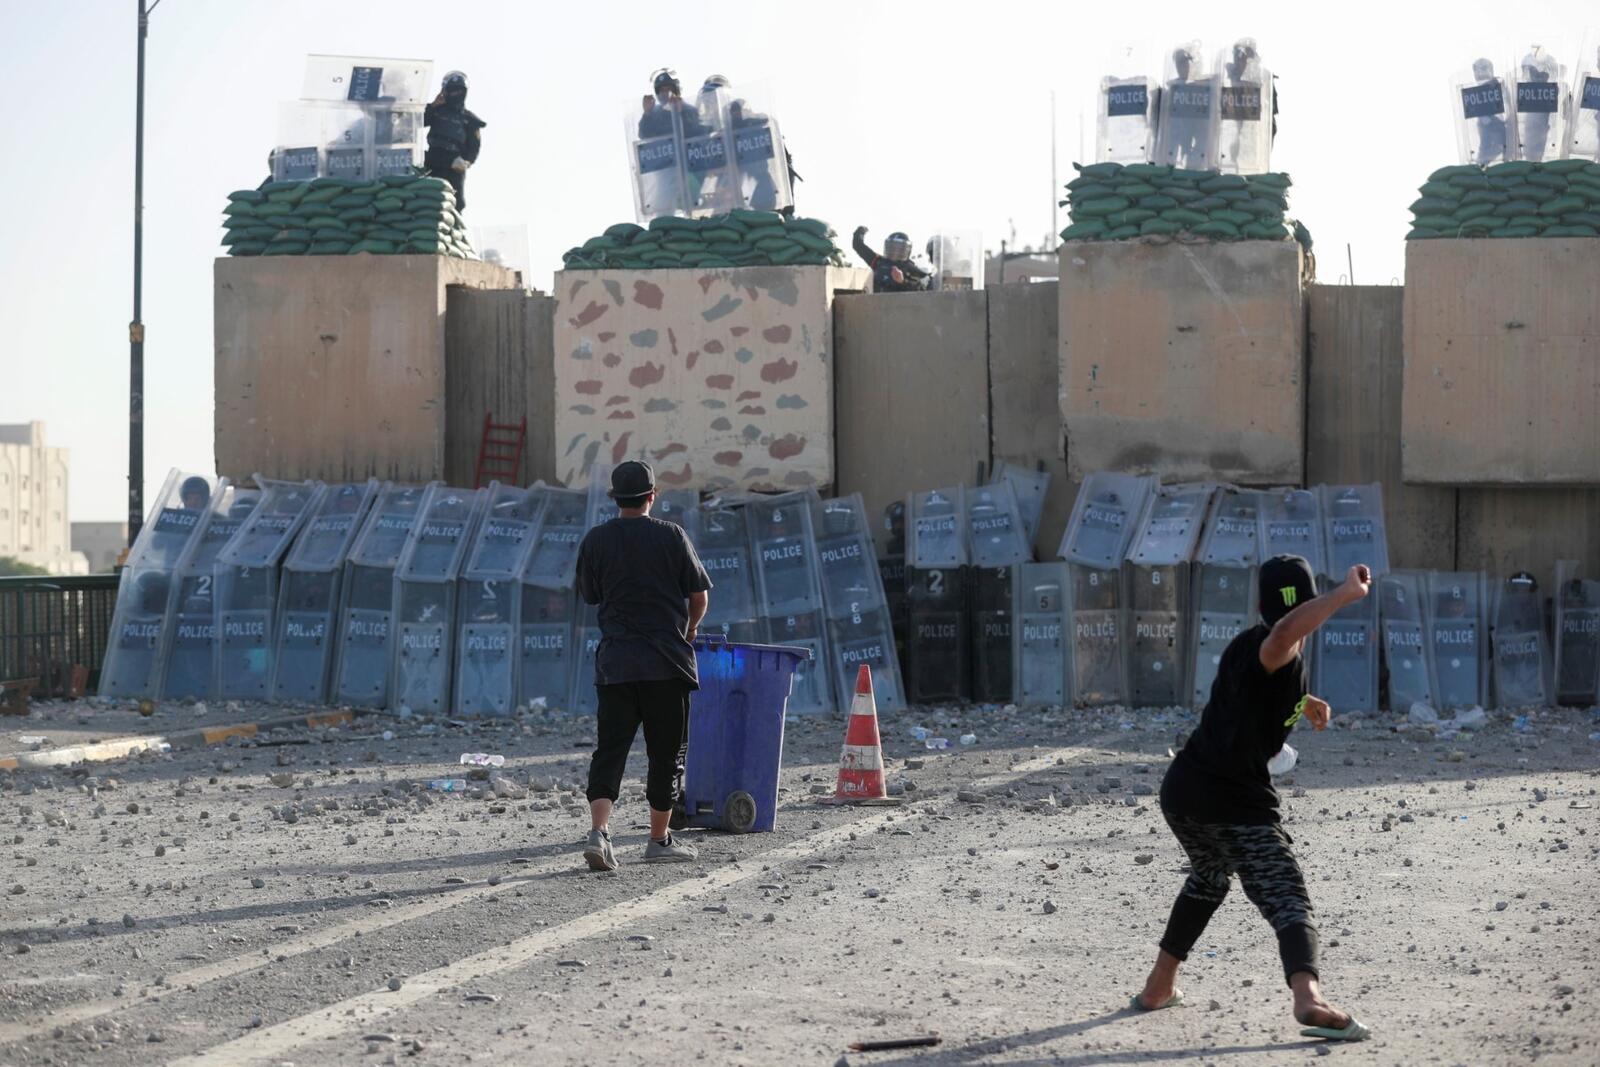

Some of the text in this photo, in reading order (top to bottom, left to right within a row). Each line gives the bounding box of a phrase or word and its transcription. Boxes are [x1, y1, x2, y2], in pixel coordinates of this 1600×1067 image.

[354, 68, 371, 100] POLICE
[1109, 91, 1145, 104] POLICE
[1173, 92, 1209, 106] POLICE
[1222, 94, 1259, 108] POLICE
[1464, 89, 1501, 106] POLICE
[1519, 88, 1556, 101] POLICE
[344, 130, 352, 141] 5
[737, 134, 771, 153] POLICE
[640, 144, 674, 161] POLICE
[688, 143, 723, 161] POLICE
[286, 153, 317, 167] POLICE
[329, 155, 362, 169] POLICE
[377, 153, 412, 168] POLICE
[160, 512, 197, 526] POLICE
[1084, 509, 1123, 523] POLICE
[314, 520, 351, 531] POLICE
[377, 519, 413, 530] POLICE
[918, 520, 954, 532] POLICE
[972, 517, 1010, 530] POLICE
[1334, 523, 1372, 536] POLICE
[423, 525, 461, 537] POLICE
[487, 525, 525, 538] POLICE
[542, 532, 580, 543] POLICE
[1270, 526, 1309, 536] POLICE
[763, 544, 802, 561] POLICE
[822, 544, 861, 562] POLICE
[241, 566, 250, 578] 2
[997, 567, 1006, 579] 2
[1089, 572, 1098, 586] 8
[1152, 571, 1160, 585] 8
[196, 576, 212, 596] 2
[928, 570, 943, 593] 2
[1219, 575, 1228, 589] 8
[1040, 596, 1049, 610] 5
[124, 624, 159, 637] POLICE
[178, 625, 215, 638] POLICE
[226, 622, 263, 636] POLICE
[350, 621, 387, 636] POLICE
[918, 625, 956, 638] POLICE
[985, 624, 1010, 637] POLI
[1024, 624, 1060, 640] POLICE
[1077, 623, 1115, 638] POLICE
[1137, 623, 1176, 638] POLICE
[1201, 624, 1240, 640] POLICE
[1564, 619, 1598, 633] POLICE
[403, 635, 441, 649] POLICE
[468, 636, 506, 650] POLICE
[524, 635, 563, 649] POLICE
[1325, 631, 1365, 646] POLICE
[1389, 631, 1422, 646] POLICE
[1436, 630, 1474, 644] POLICE
[842, 646, 882, 663] POLICE
[1500, 641, 1537, 656] POLICE
